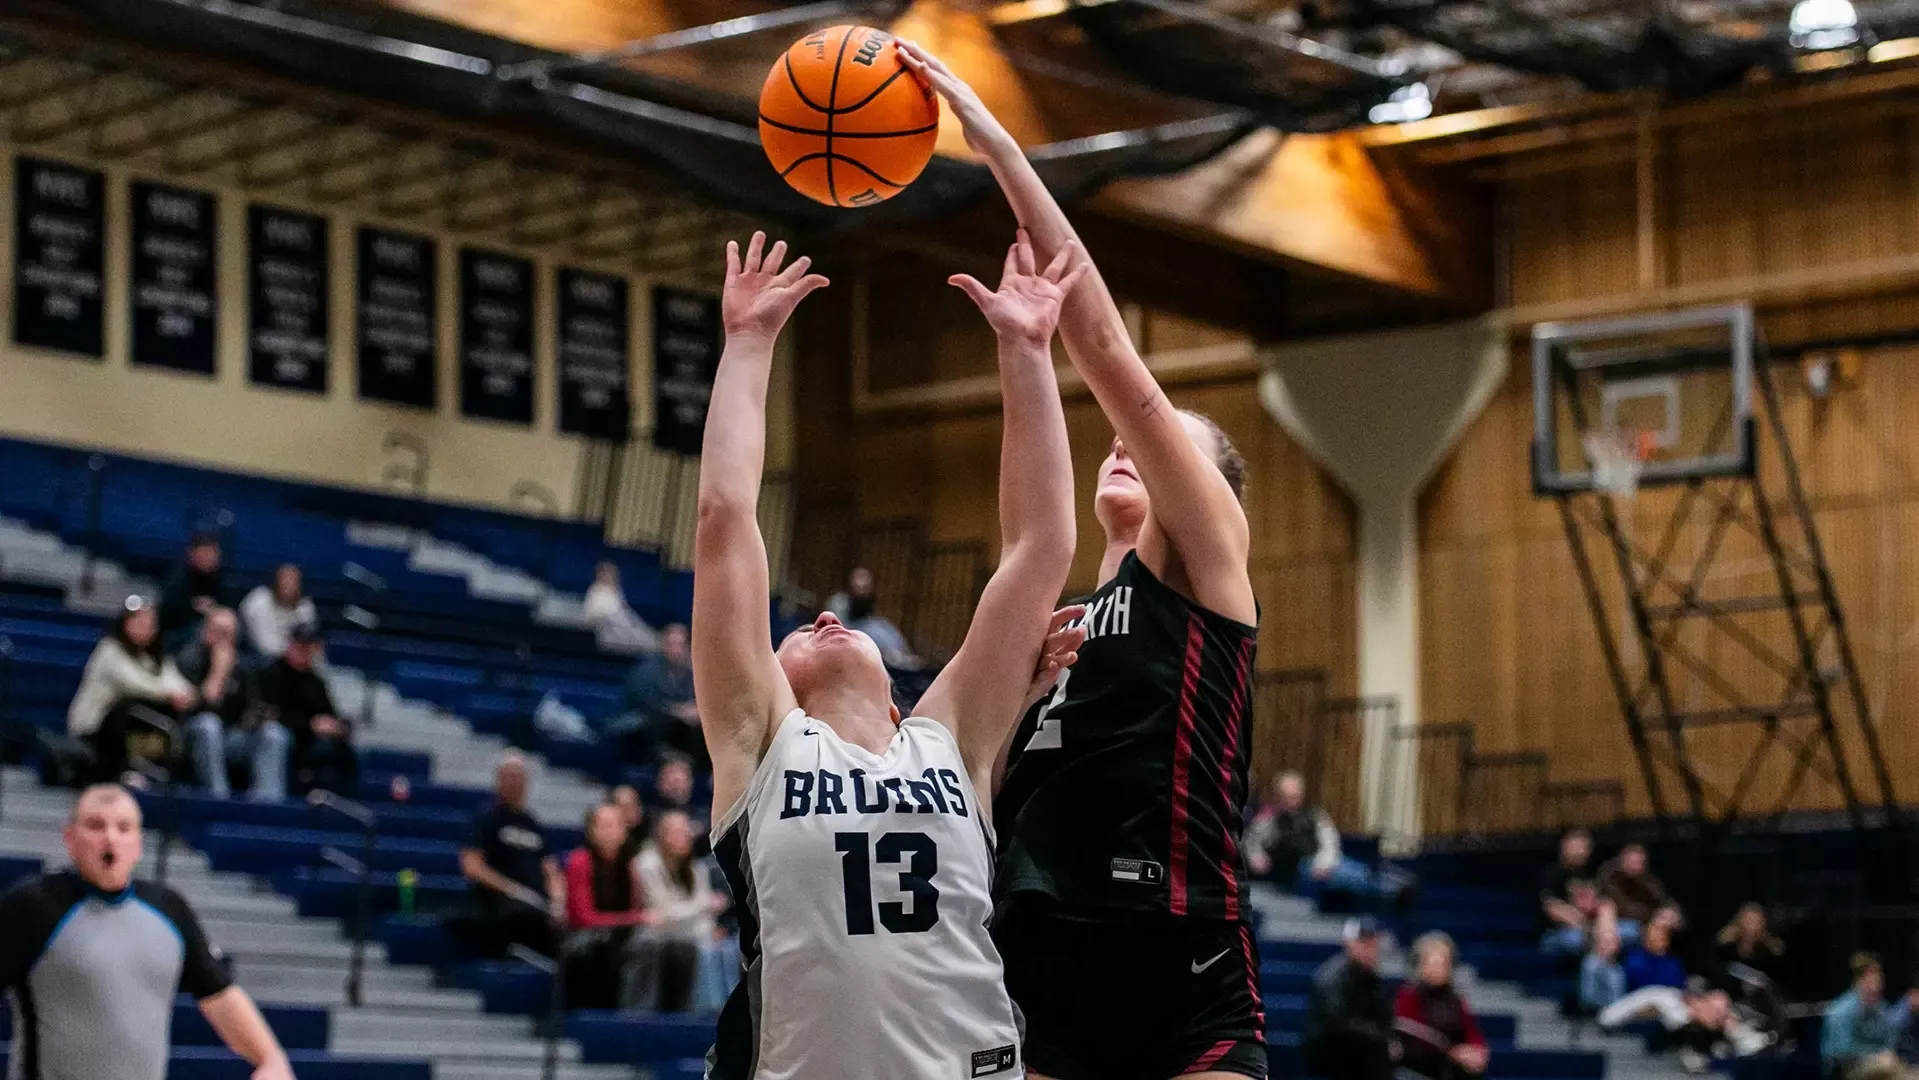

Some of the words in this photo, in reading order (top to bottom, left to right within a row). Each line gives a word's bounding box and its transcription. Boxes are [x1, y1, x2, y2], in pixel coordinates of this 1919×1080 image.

[780, 767, 968, 820] BRUINS
[834, 832, 940, 936] 13
[1147, 867, 1156, 879] L
[1002, 1054, 1011, 1065] M
